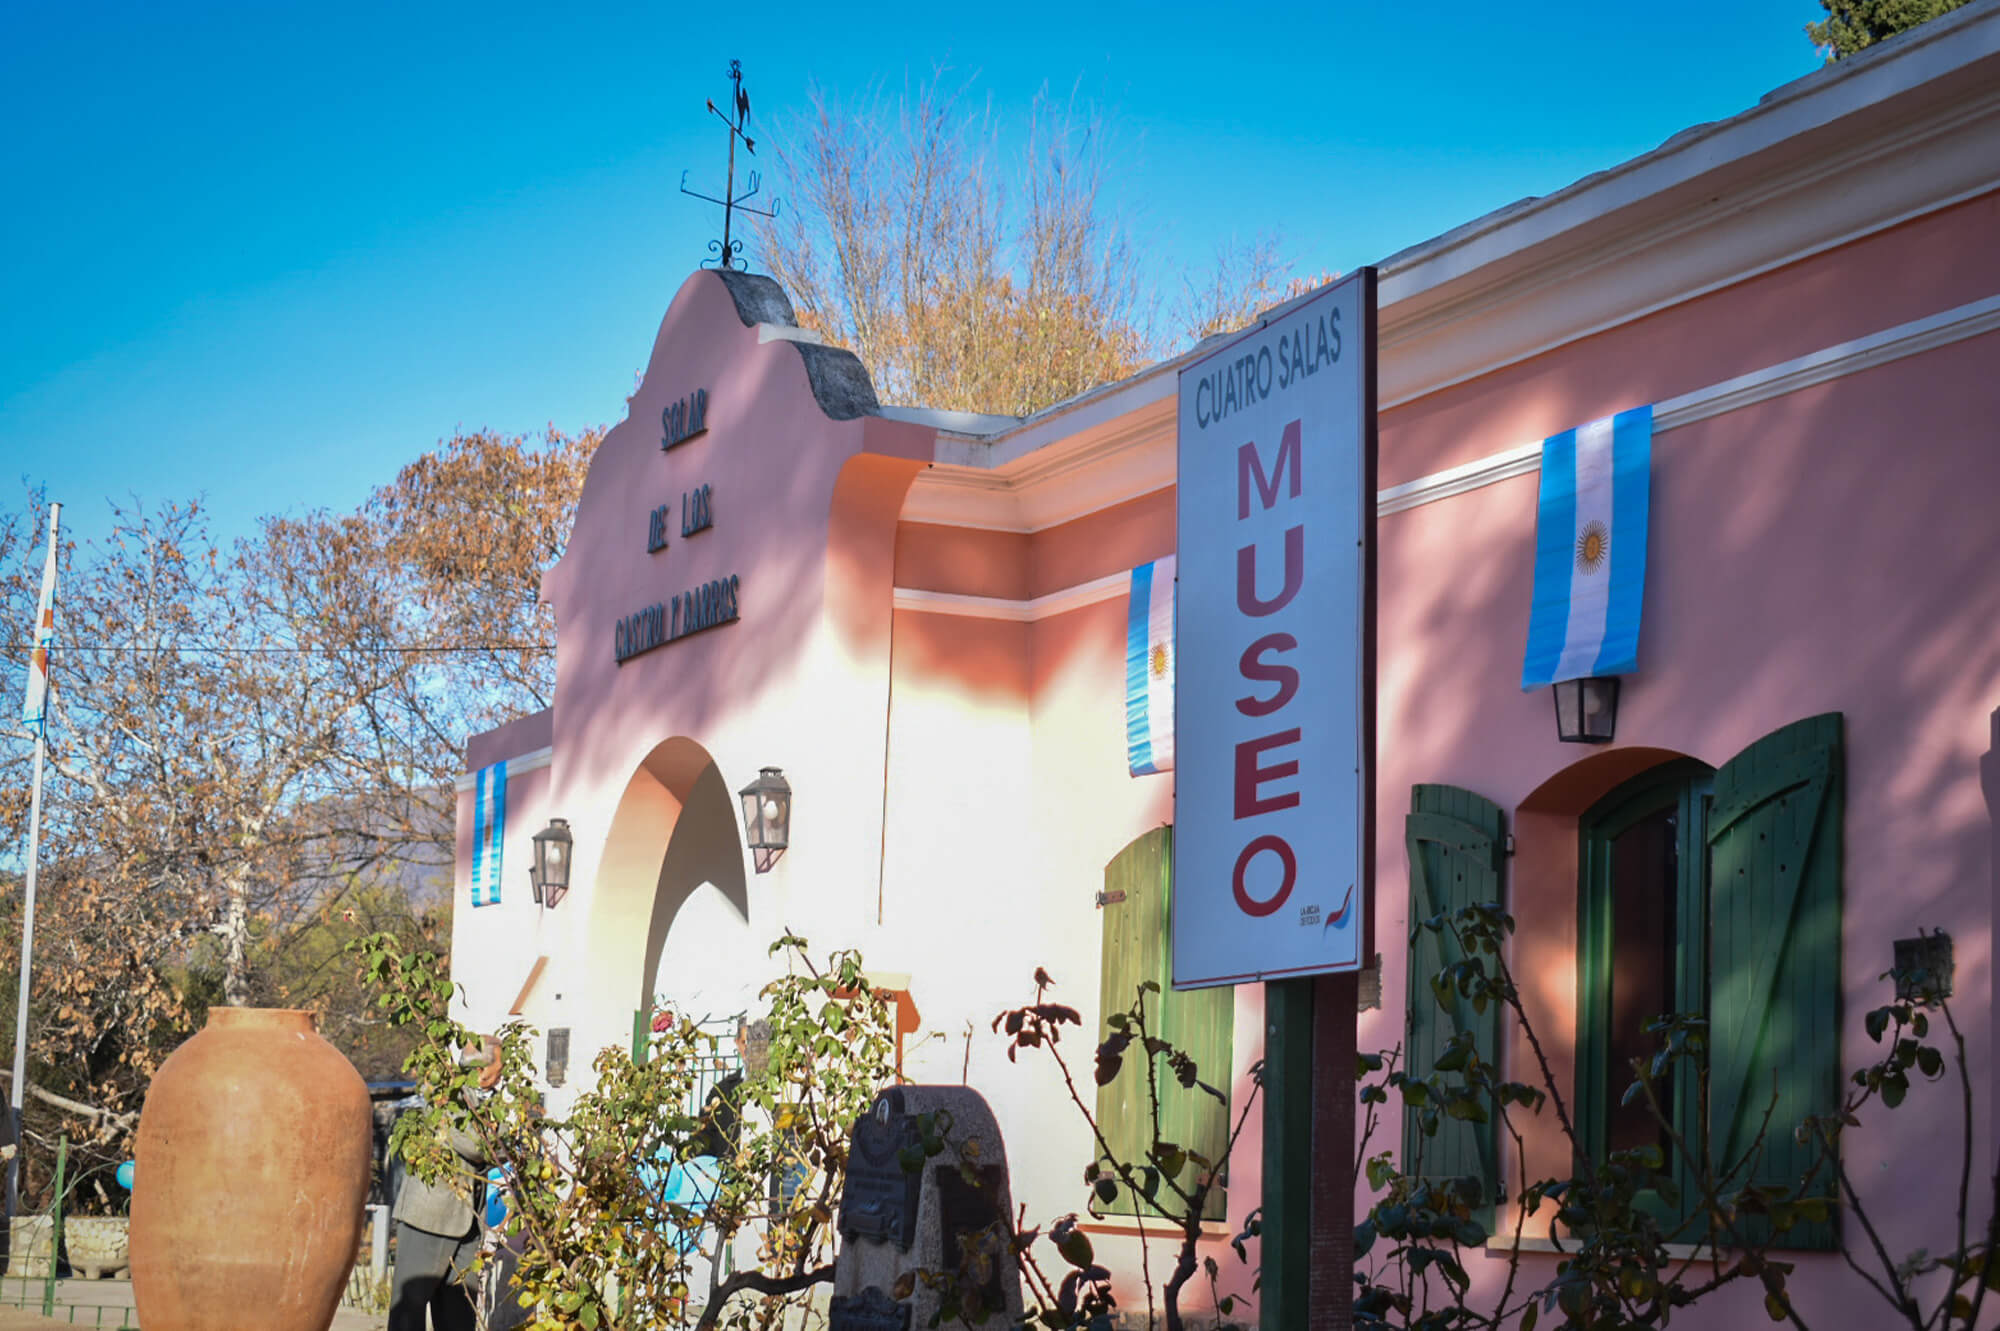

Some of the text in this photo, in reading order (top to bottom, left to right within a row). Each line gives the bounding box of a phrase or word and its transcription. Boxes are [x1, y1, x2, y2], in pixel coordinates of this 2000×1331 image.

[1196, 306, 1341, 429] CUATRO SALAS
[661, 387, 707, 449] SOLAR
[648, 483, 712, 552] DE LOS
[615, 574, 739, 660] CASTRO Y BARROS
[1233, 418, 1302, 917] MUSEO
